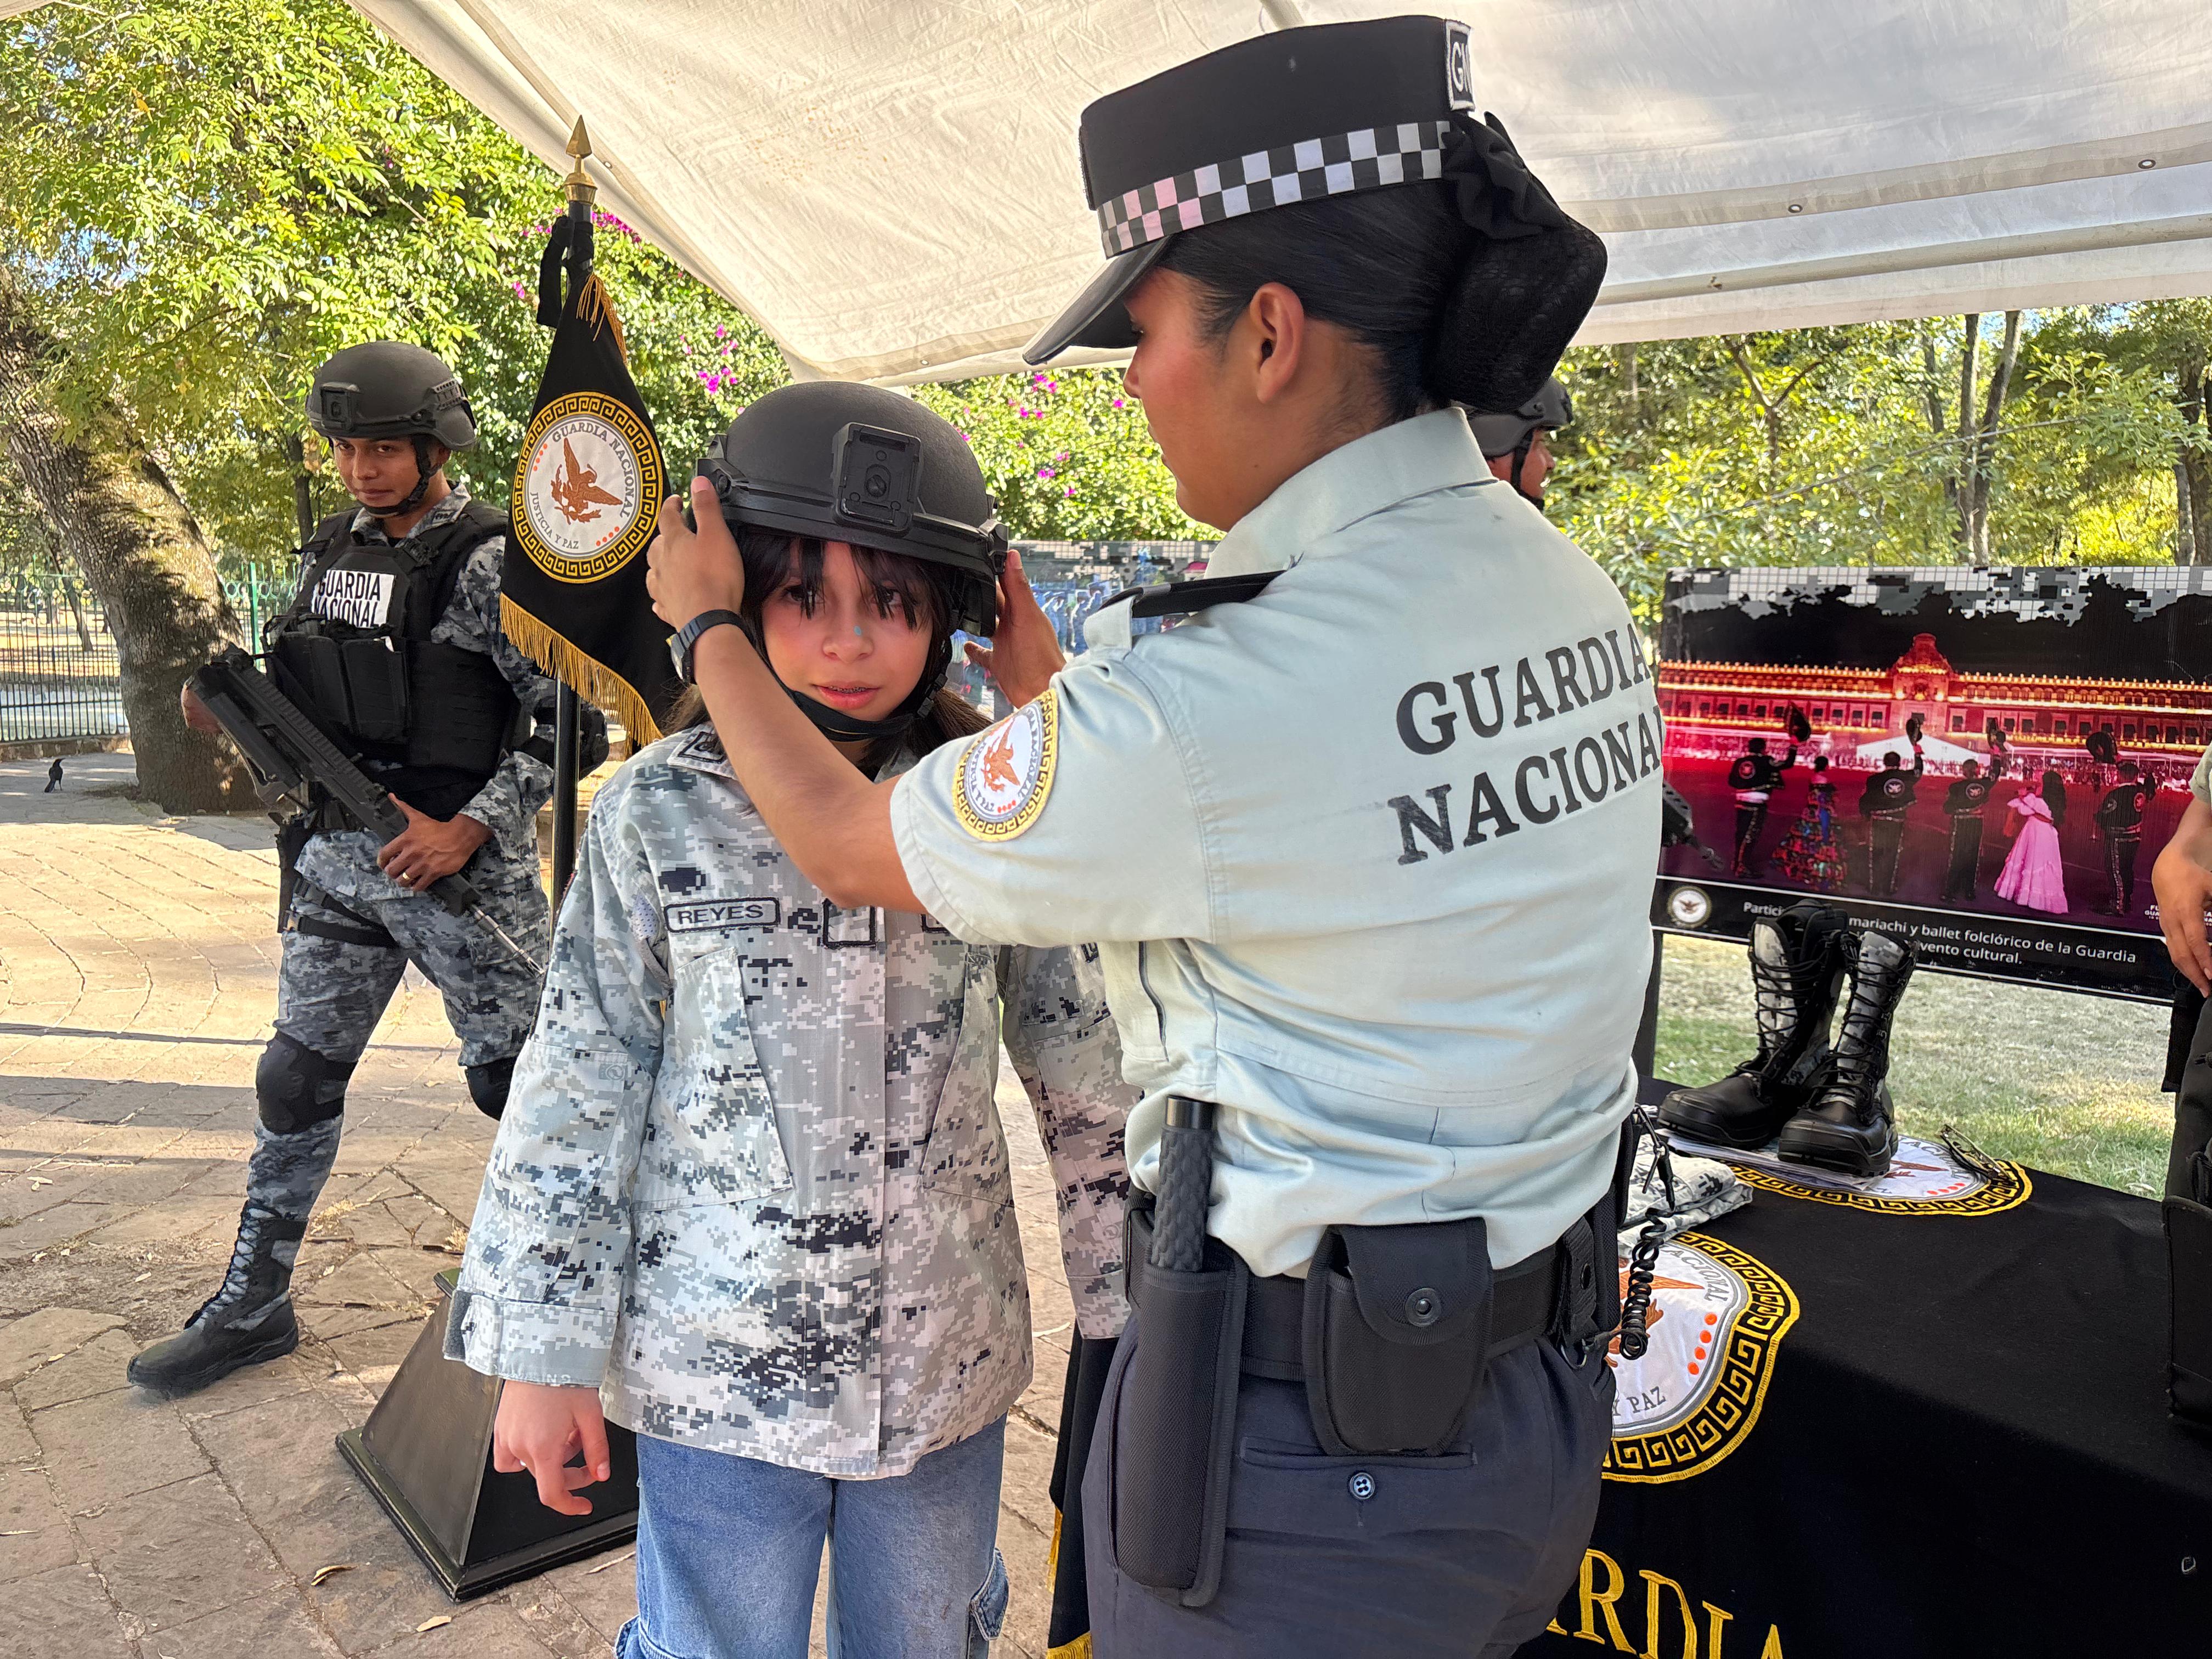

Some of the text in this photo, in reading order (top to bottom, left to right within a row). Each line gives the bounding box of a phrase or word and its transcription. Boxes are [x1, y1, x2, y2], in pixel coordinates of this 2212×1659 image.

[552, 422, 634, 518] GUARDIA NACIONAL
[530, 492, 579, 549] JUSTICIA Y PAZ
[318, 569, 381, 602] GUARDIA
[1396, 623, 1651, 755] GUARDIA
[678, 905, 764, 925] REYES
[1743, 901, 2136, 963] Partici mariachi y ballet folclórico de la Guardia
[1920, 941, 2022, 964] vento cultural.
[1659, 1244, 1730, 1302] ACIONAL
[1626, 1386, 1667, 1414] PAZ
